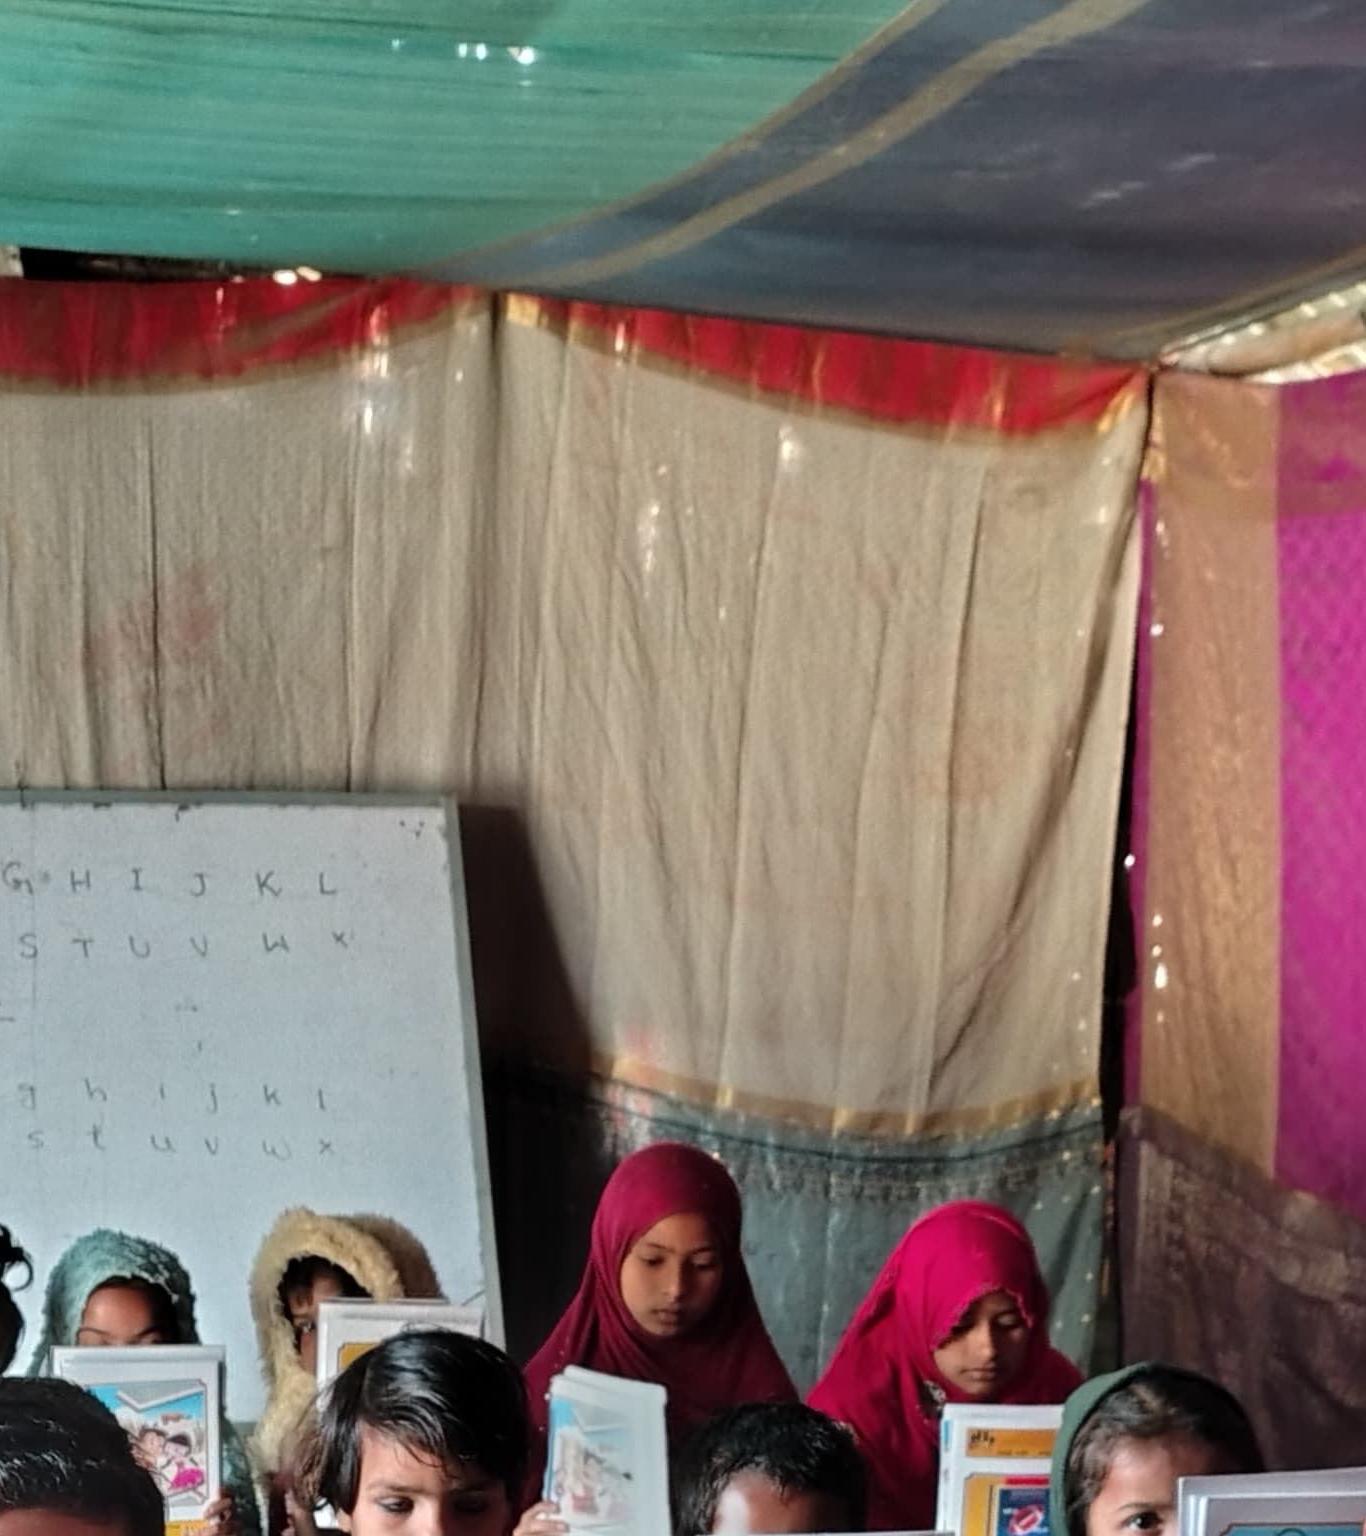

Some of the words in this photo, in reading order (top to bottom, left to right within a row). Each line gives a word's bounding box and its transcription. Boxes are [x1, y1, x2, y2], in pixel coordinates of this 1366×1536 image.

[1, 860, 34, 896] G
[69, 868, 92, 894] H
[131, 866, 143, 892] I
[189, 872, 207, 898] J
[255, 870, 283, 898] K
[318, 870, 337, 896] L
[19, 932, 39, 960] S
[71, 937, 94, 958] T
[128, 934, 151, 959] U
[189, 936, 209, 958] V
[261, 932, 290, 954] W
[332, 931, 348, 948] X
